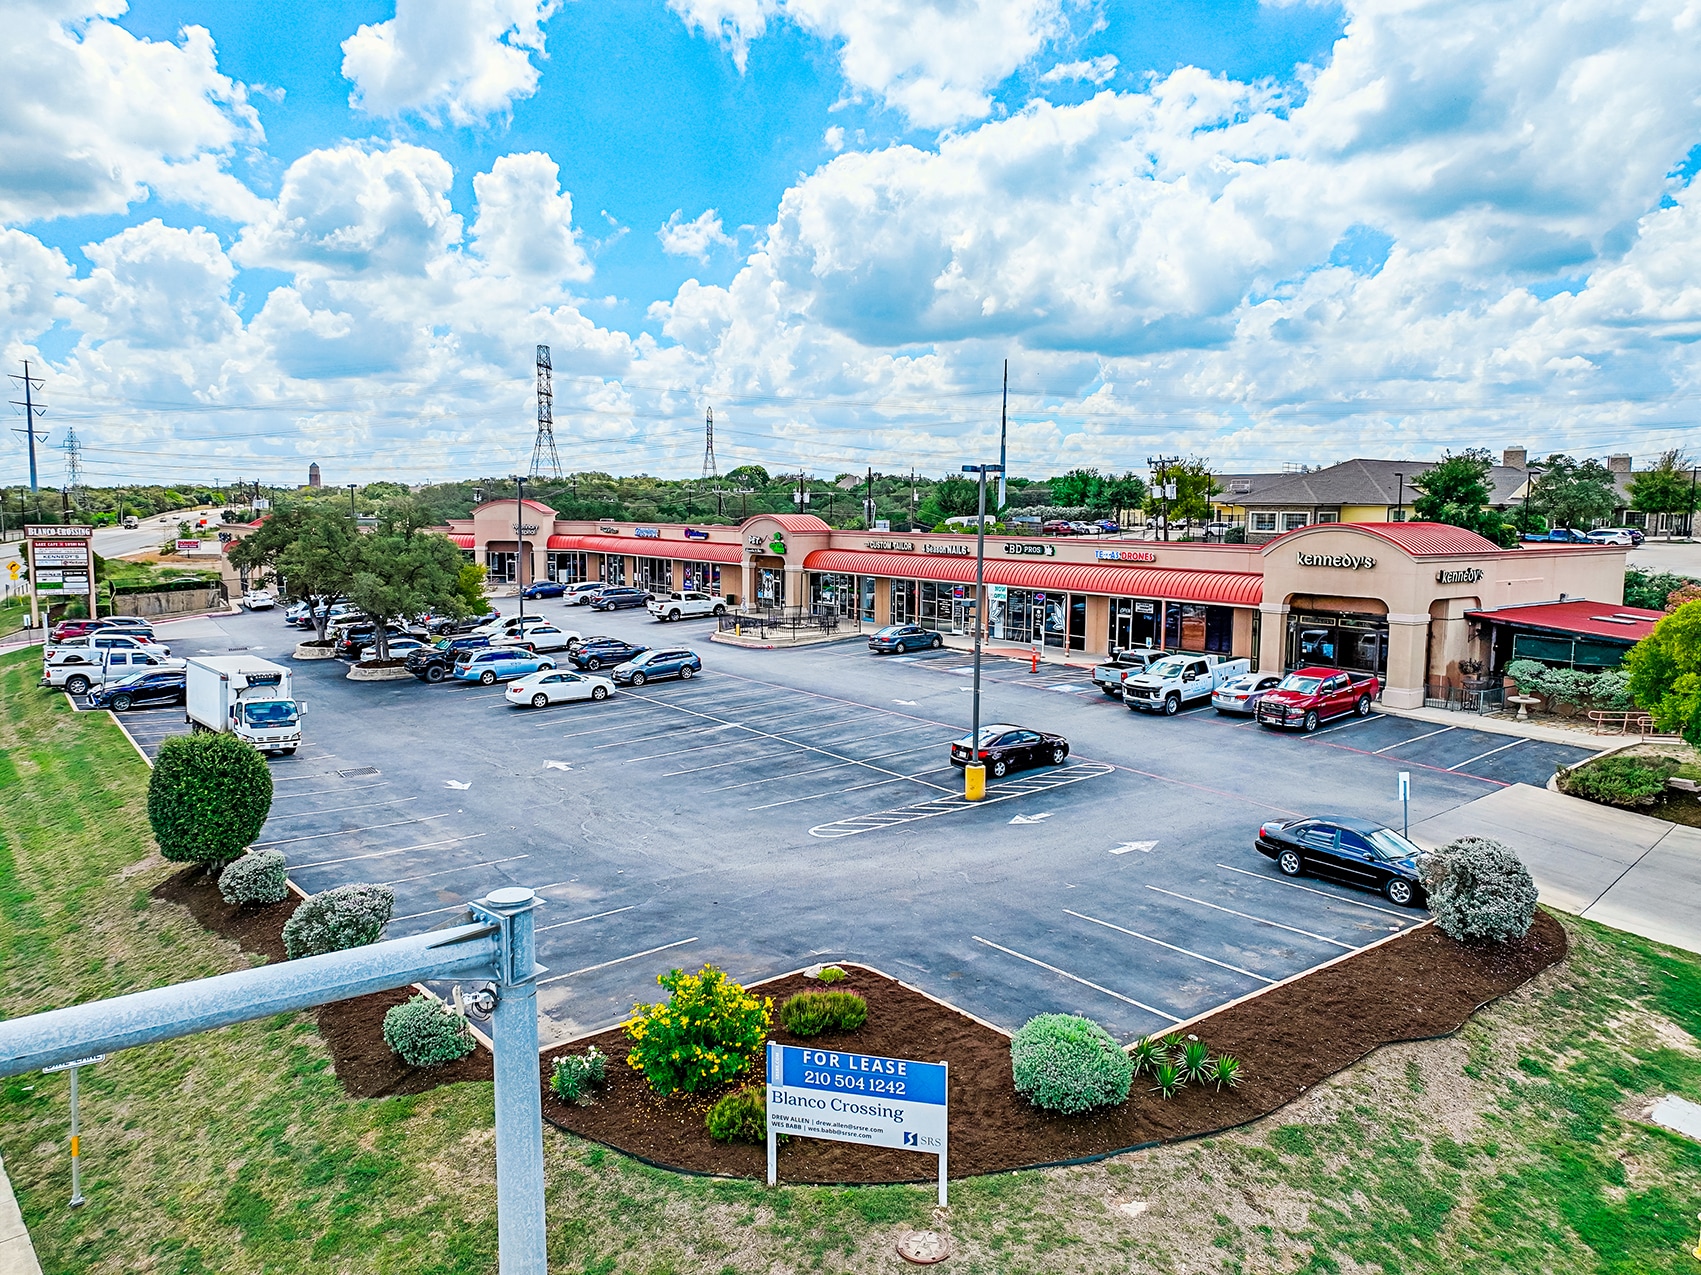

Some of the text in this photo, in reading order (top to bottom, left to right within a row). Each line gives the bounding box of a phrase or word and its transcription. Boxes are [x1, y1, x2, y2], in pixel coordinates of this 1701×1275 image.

[28, 527, 91, 536] BLANCO CROSSING
[870, 541, 913, 551] CUSTOM TAILOR
[947, 545, 968, 555] NAILS
[1003, 544, 1041, 554] CBD PROS
[1121, 551, 1155, 562] DRONES
[1296, 551, 1374, 571] kennedy's
[1439, 568, 1484, 584] kennedy's
[803, 1050, 907, 1076] FOR LEASE
[804, 1070, 906, 1095] 210 504 1242
[771, 1090, 904, 1123] Blanco Crossing
[771, 1113, 884, 1133] DREW ALLEN drew.allen@srsre.com
[808, 1126, 872, 1140] wes.babb@srsre.com
[920, 1135, 942, 1147] SRS
